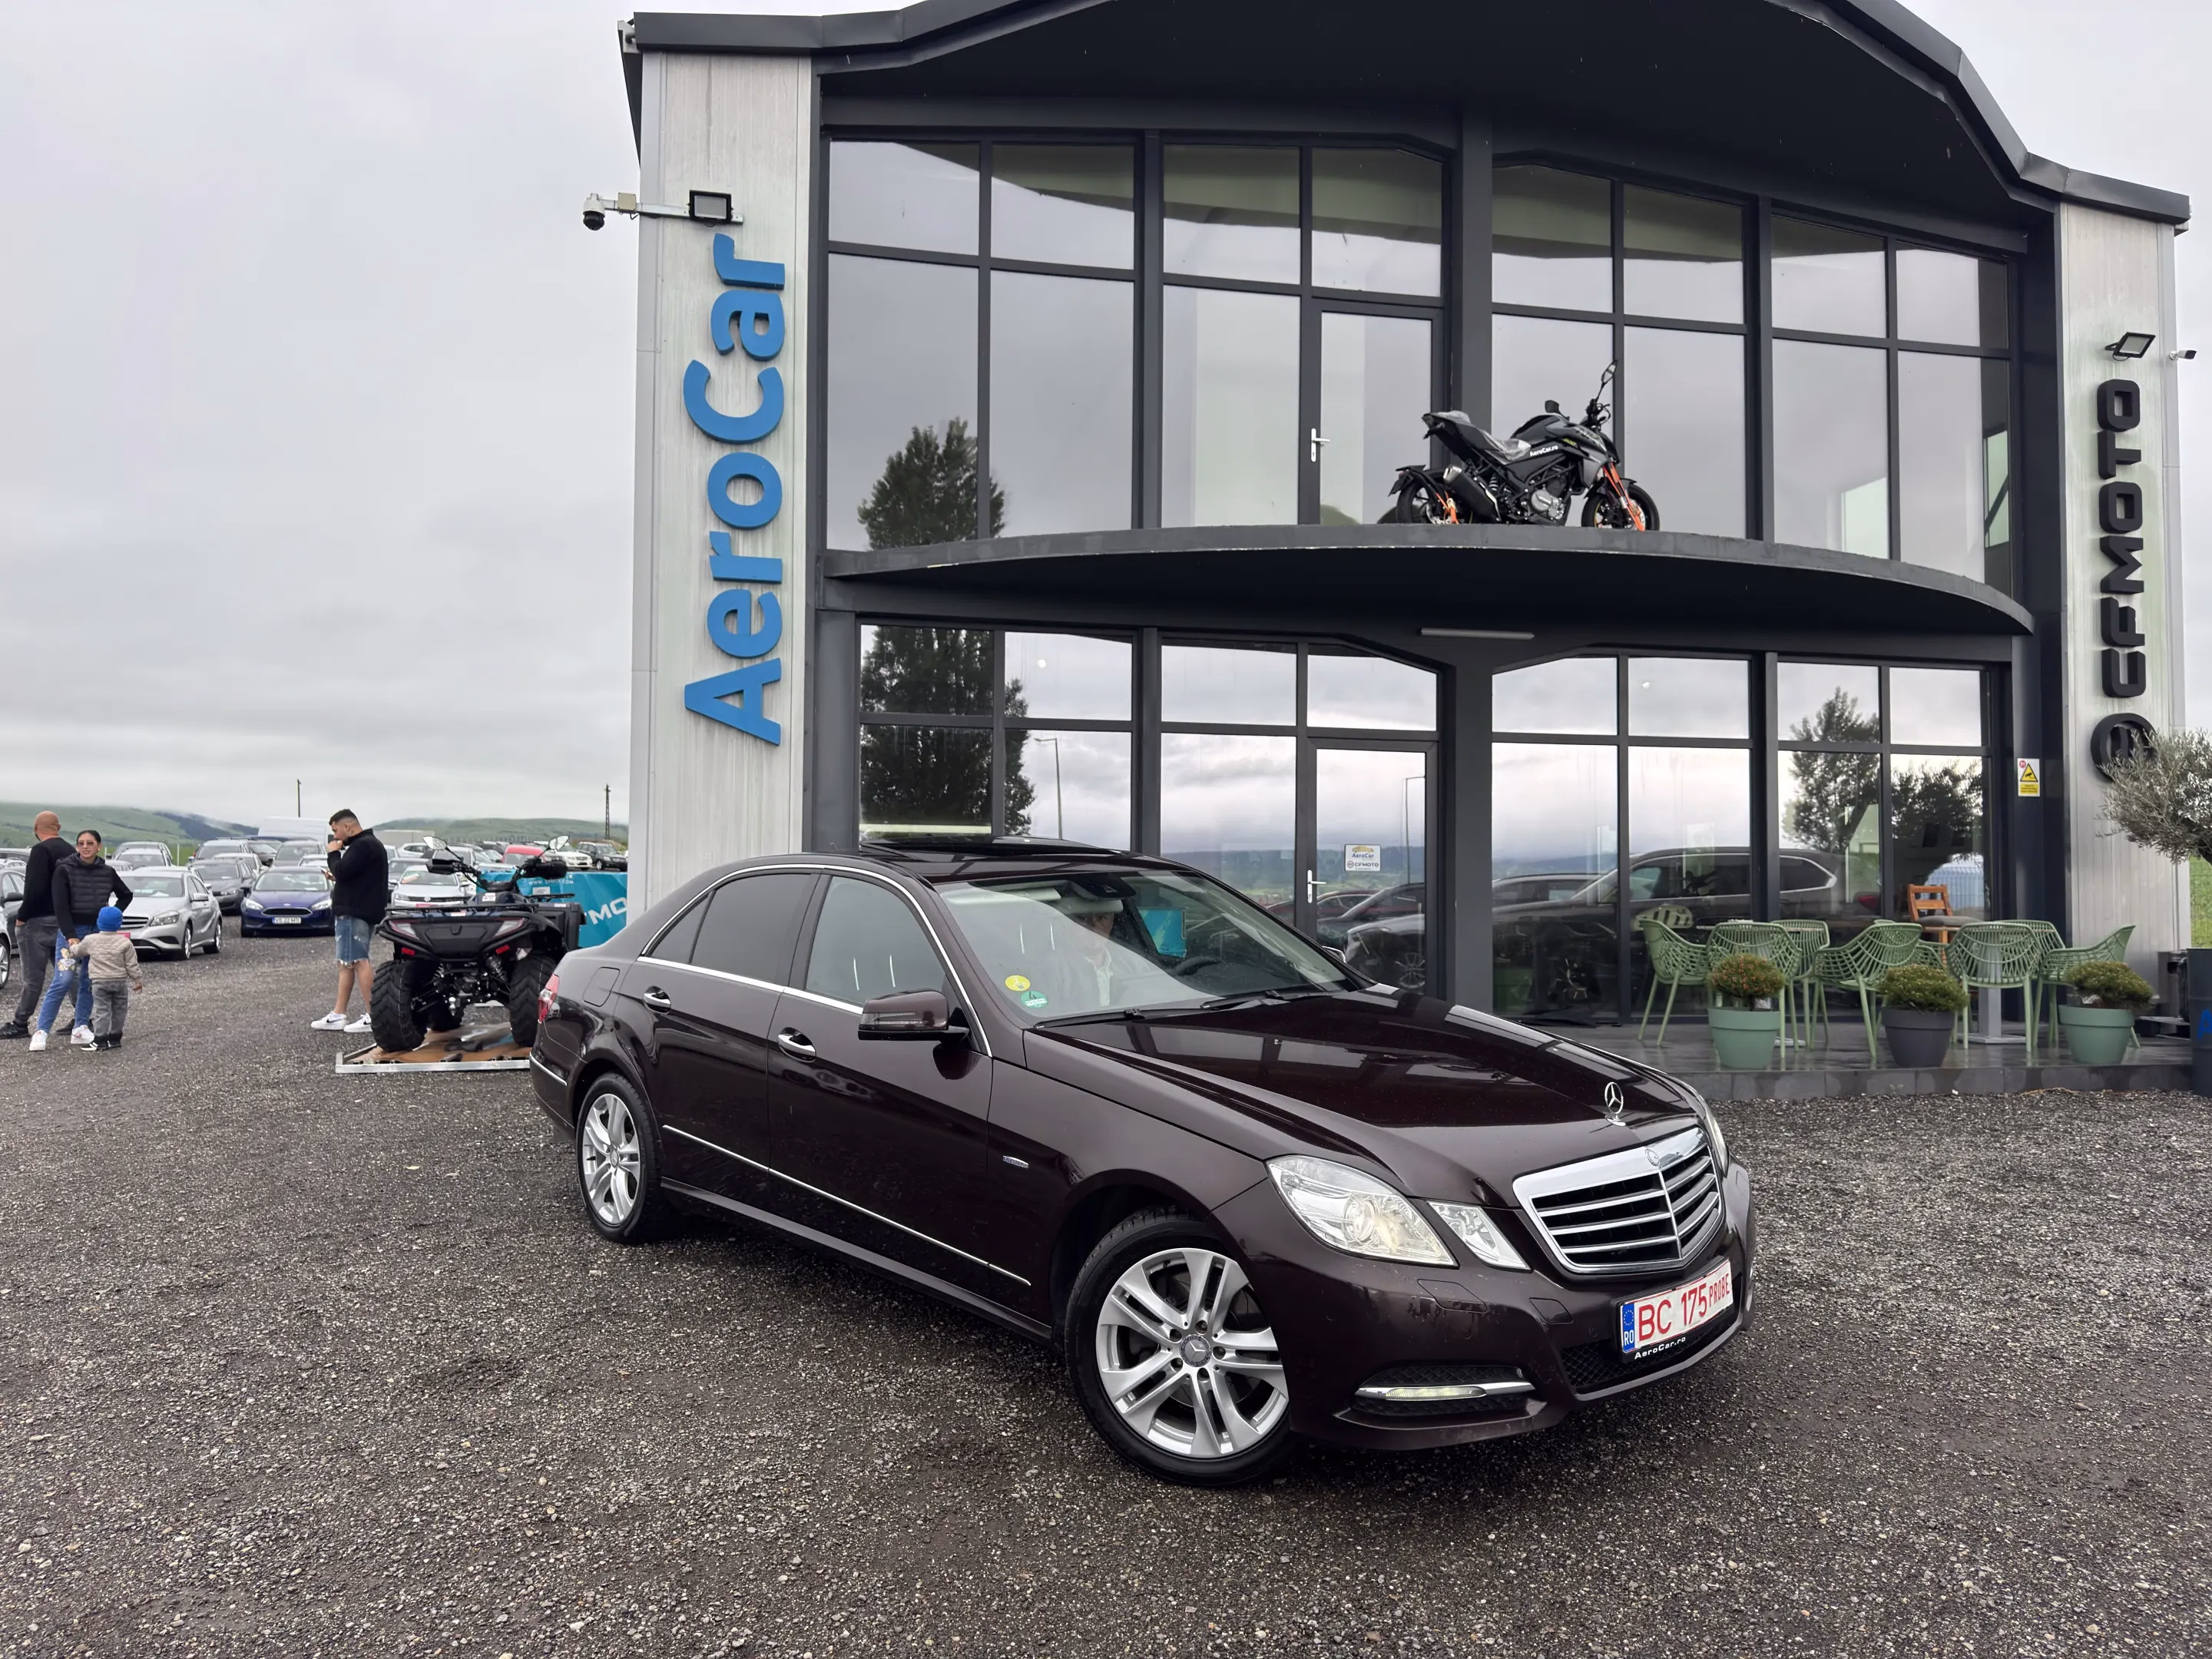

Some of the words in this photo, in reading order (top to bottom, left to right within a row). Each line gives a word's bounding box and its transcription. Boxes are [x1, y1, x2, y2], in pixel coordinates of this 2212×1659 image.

[1529, 445, 1559, 457] AeroCar.ro
[683, 233, 786, 746] AeroCar
[2097, 379, 2145, 698] CFMOTO
[1638, 1299, 1672, 1342] BC
[1681, 1283, 1707, 1326] 175
[1708, 1273, 1730, 1307] PROBE
[1624, 1330, 1634, 1346] RO
[1634, 1336, 1686, 1359] AeroCar.ro
